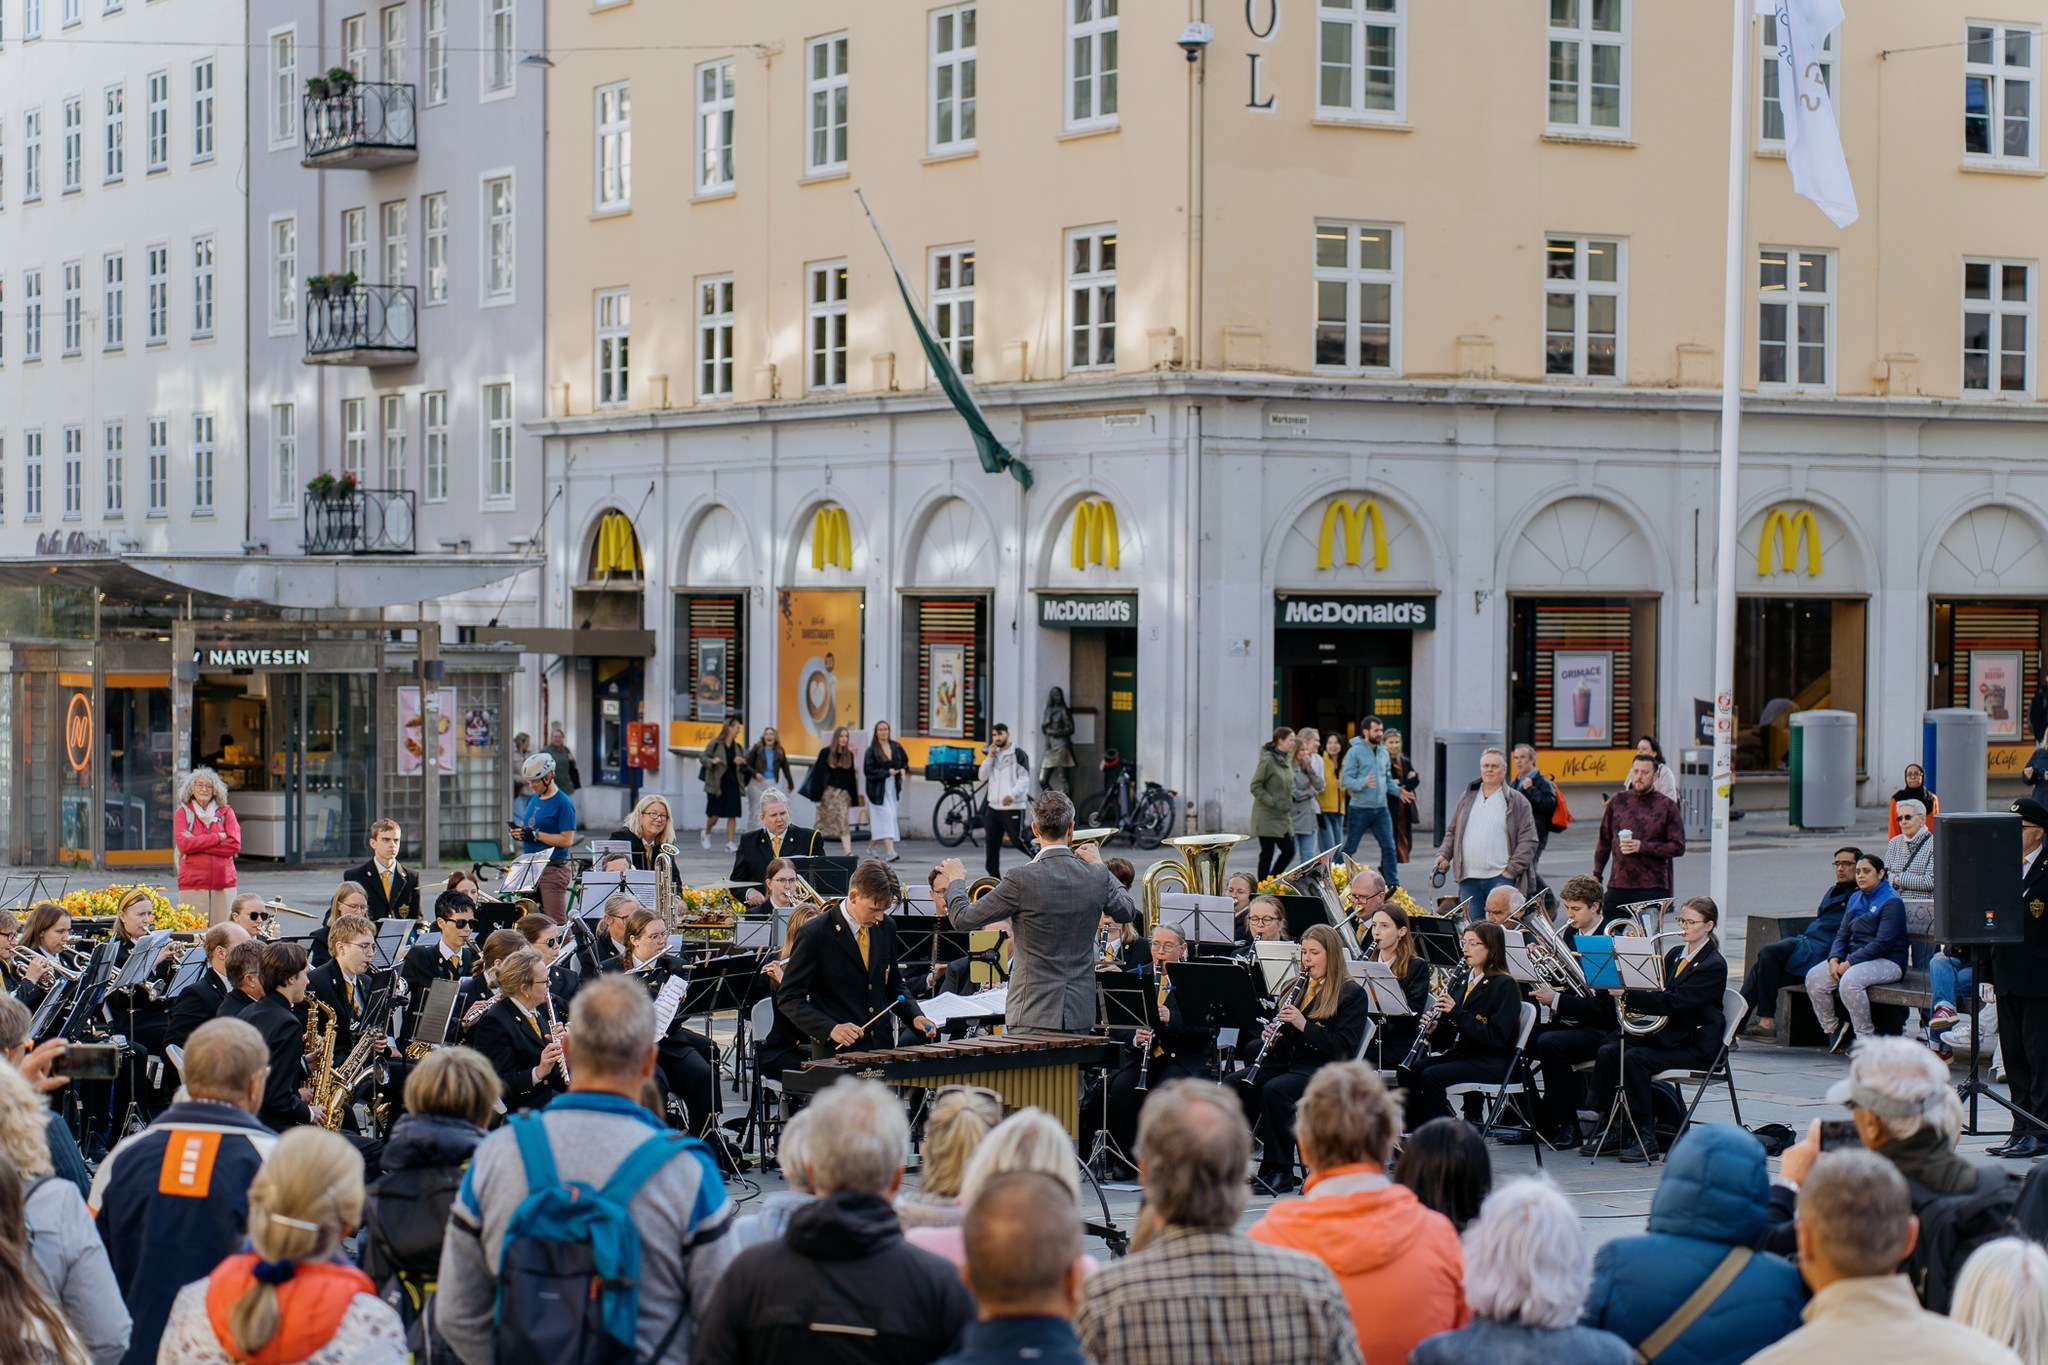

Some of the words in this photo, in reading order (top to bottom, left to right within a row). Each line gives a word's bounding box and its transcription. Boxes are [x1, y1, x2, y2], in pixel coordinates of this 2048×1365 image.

[1043, 600, 1131, 621] McDonald's
[1285, 601, 1427, 624] McDonald's
[209, 649, 310, 666] NARVESEN
[1561, 666, 1602, 680] GRIMACE
[1562, 754, 1607, 777] McCafé
[856, 1067, 886, 1080] majestic
